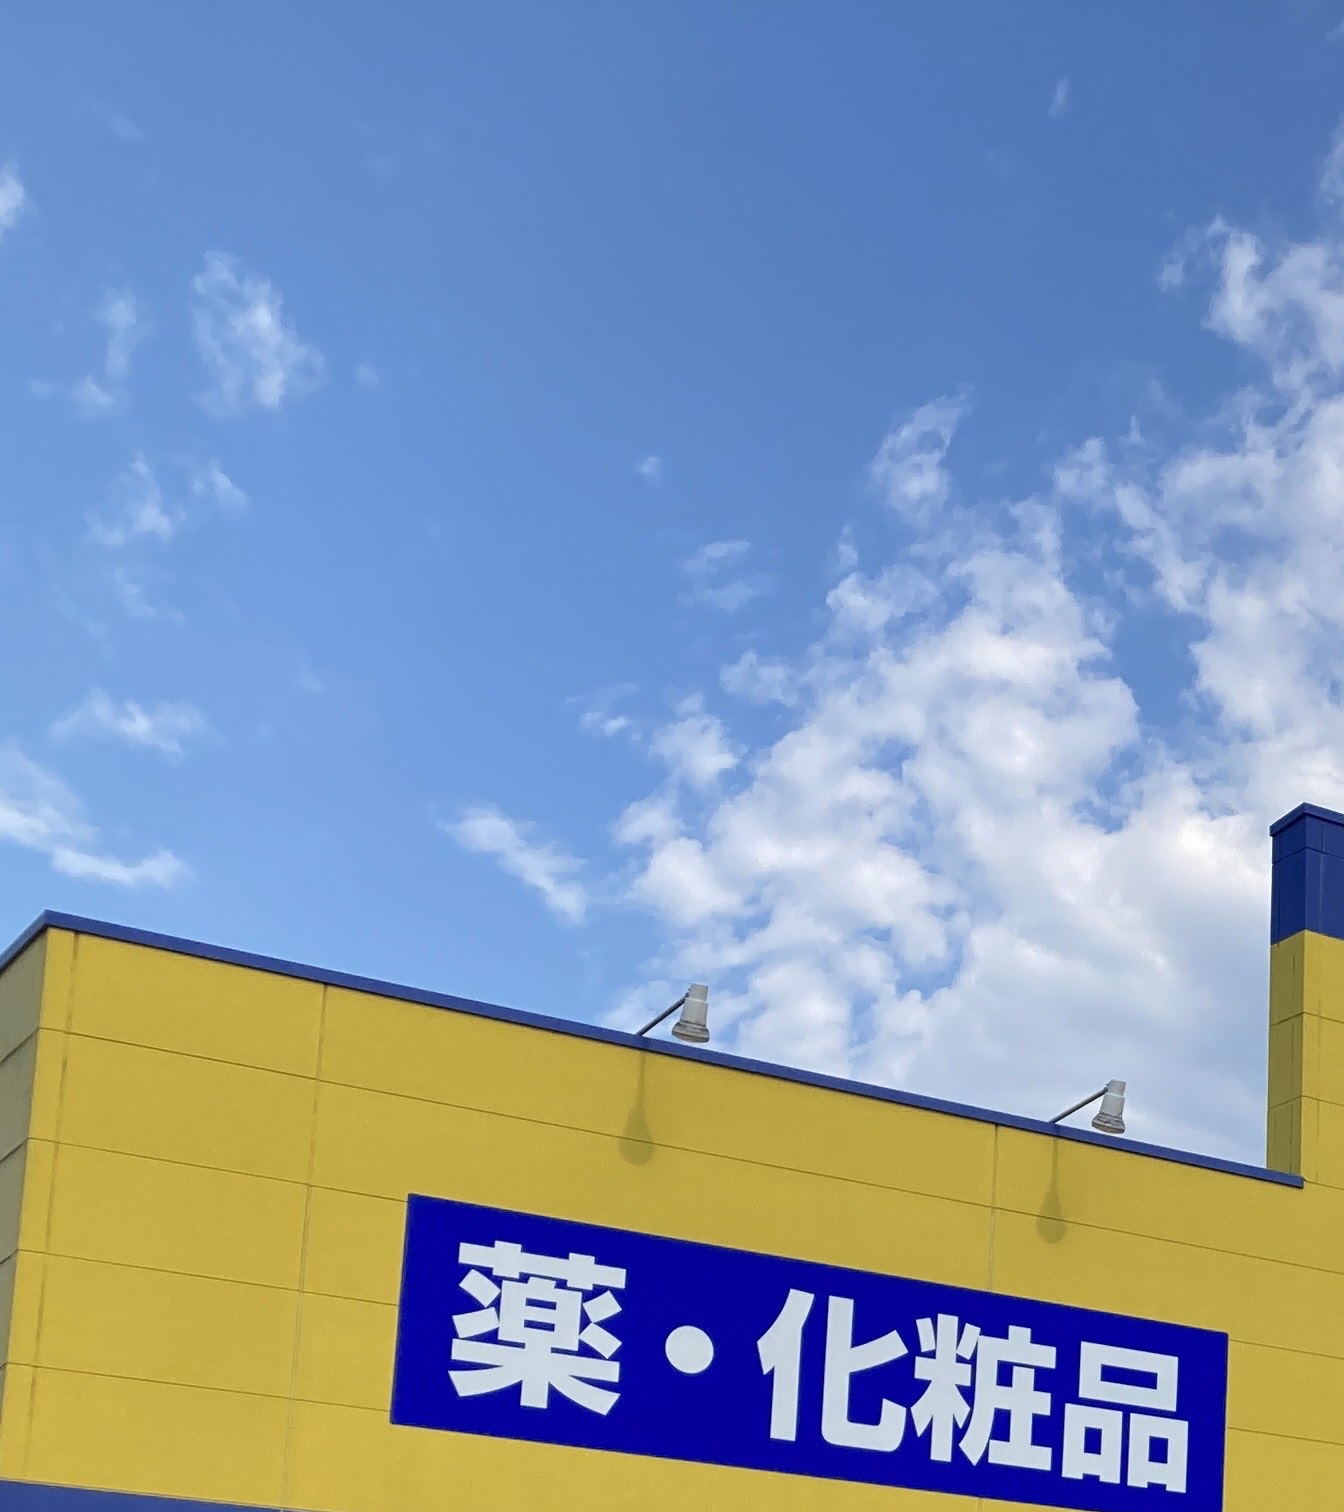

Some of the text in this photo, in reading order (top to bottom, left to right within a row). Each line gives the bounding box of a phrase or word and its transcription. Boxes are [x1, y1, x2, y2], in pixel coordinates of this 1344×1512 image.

[449, 1241, 1189, 1494] 薬・化粧品
